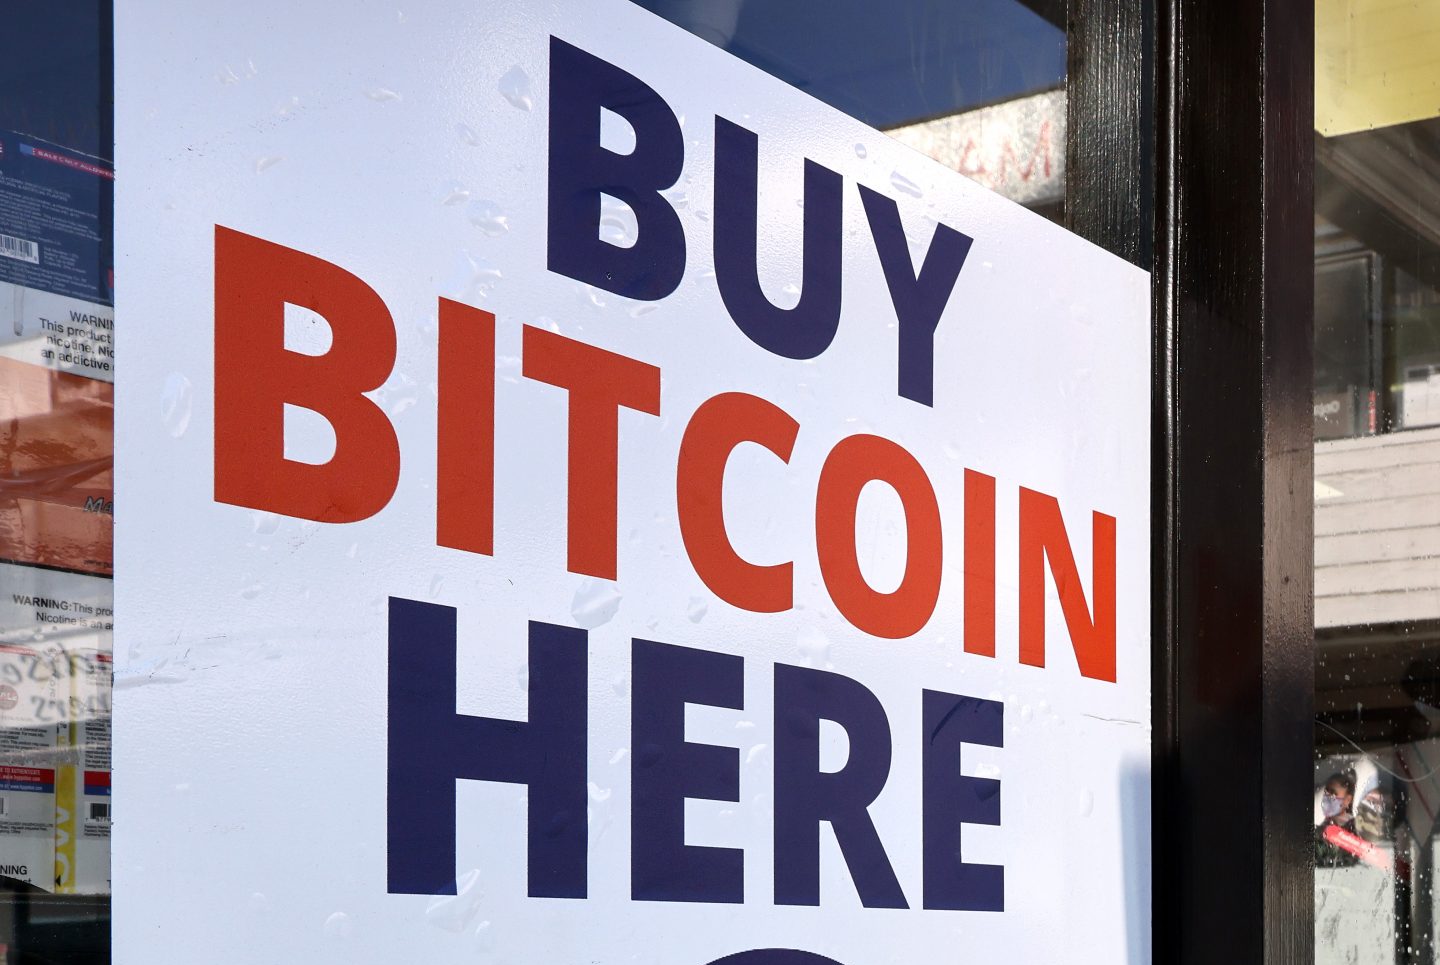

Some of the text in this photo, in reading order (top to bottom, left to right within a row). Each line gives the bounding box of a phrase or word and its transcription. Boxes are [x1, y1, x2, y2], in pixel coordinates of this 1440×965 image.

[547, 35, 973, 407] BUY
[39, 317, 111, 344] This product
[69, 310, 114, 331] WARNIN
[41, 349, 109, 371] an addictive
[214, 224, 1117, 683] BITCOIN
[36, 611, 76, 625] Nicotine
[387, 596, 1004, 912] HERE
